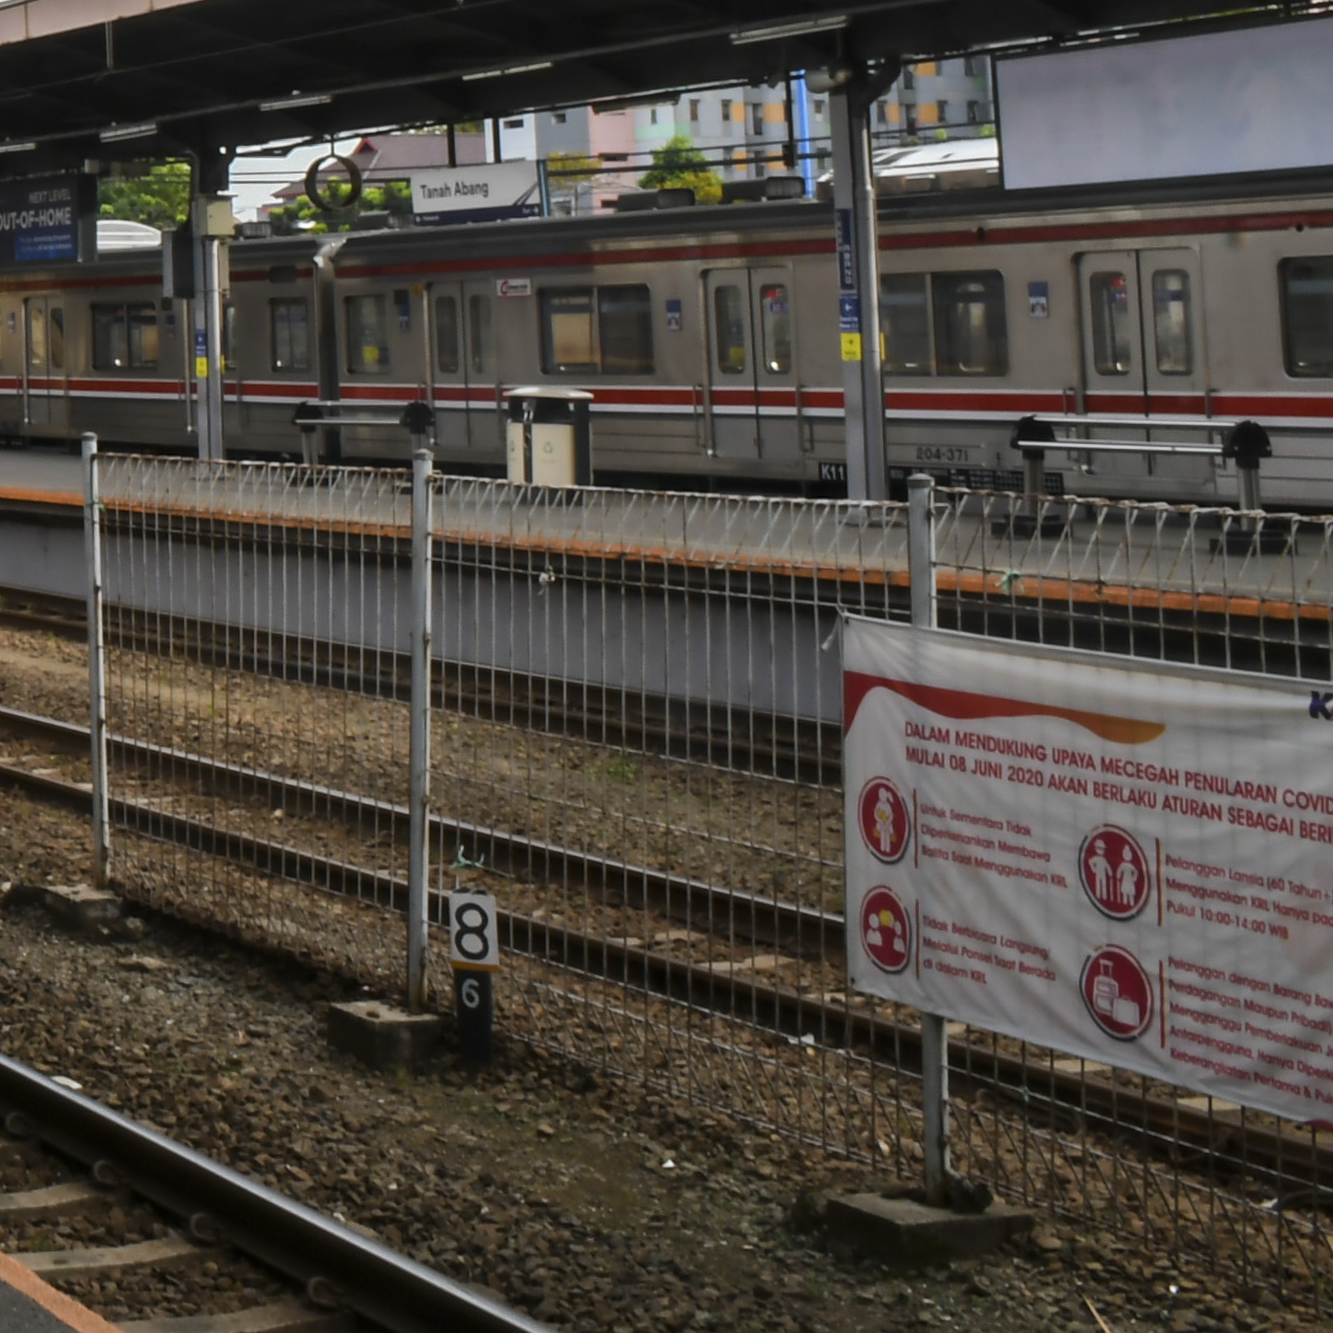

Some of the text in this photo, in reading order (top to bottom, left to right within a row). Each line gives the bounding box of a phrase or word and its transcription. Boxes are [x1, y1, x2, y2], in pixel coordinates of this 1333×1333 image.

[28, 189, 71, 204] NEXT LEVEL
[420, 181, 489, 199] Tanah Abang
[916, 445, 968, 462] 204-371
[905, 721, 950, 745] DALAM
[955, 731, 1047, 762] MENDUKUNG
[1052, 747, 1096, 771] UPAYA
[1101, 756, 1179, 786] MECEGAH
[1185, 771, 1277, 804] PENULARAN
[906, 746, 945, 769] MULAI
[949, 755, 966, 772] 08
[971, 760, 1002, 780] JUNI
[1007, 766, 1043, 787] 2020
[1048, 774, 1088, 796] AKAN
[1093, 781, 1157, 809] BERLAKU
[1162, 795, 1222, 822] ATURAN
[1228, 807, 1294, 837] SEBAGAI
[920, 804, 1032, 837] Untuk Sementara Tidak
[998, 840, 1051, 863] Membawa
[951, 851, 972, 865] Saat
[974, 856, 1048, 884] Menggunakan
[1051, 873, 1068, 888] KRL
[1166, 854, 1226, 878] Pelanggan
[1229, 868, 1264, 887] Lansia
[1288, 880, 1322, 900] Tahun
[1166, 877, 1247, 906] Menggunakan
[1250, 895, 1270, 911] KRL
[1273, 901, 1309, 922] Hanya
[455, 902, 489, 960] 8
[922, 915, 948, 931] Tidak
[1167, 899, 1289, 940] Pukul 10:00-14:00 WIB
[935, 960, 968, 979] dalam
[970, 970, 987, 985] KRL
[961, 946, 992, 963] Ponsel
[995, 955, 1016, 970] Saat
[1018, 962, 1056, 982] Berada
[462, 978, 480, 1008] 6
[1168, 956, 1226, 980] Pelanggan
[1229, 972, 1271, 993] dengan
[1273, 983, 1312, 1007] Barang
[1169, 979, 1241, 1008] Perdagangan
[1244, 998, 1288, 1021] Maupun
[1170, 1001, 1242, 1032] Mengganggu
[1257, 1049, 1294, 1070] Hanya
[1253, 1071, 1301, 1096] Pertama
